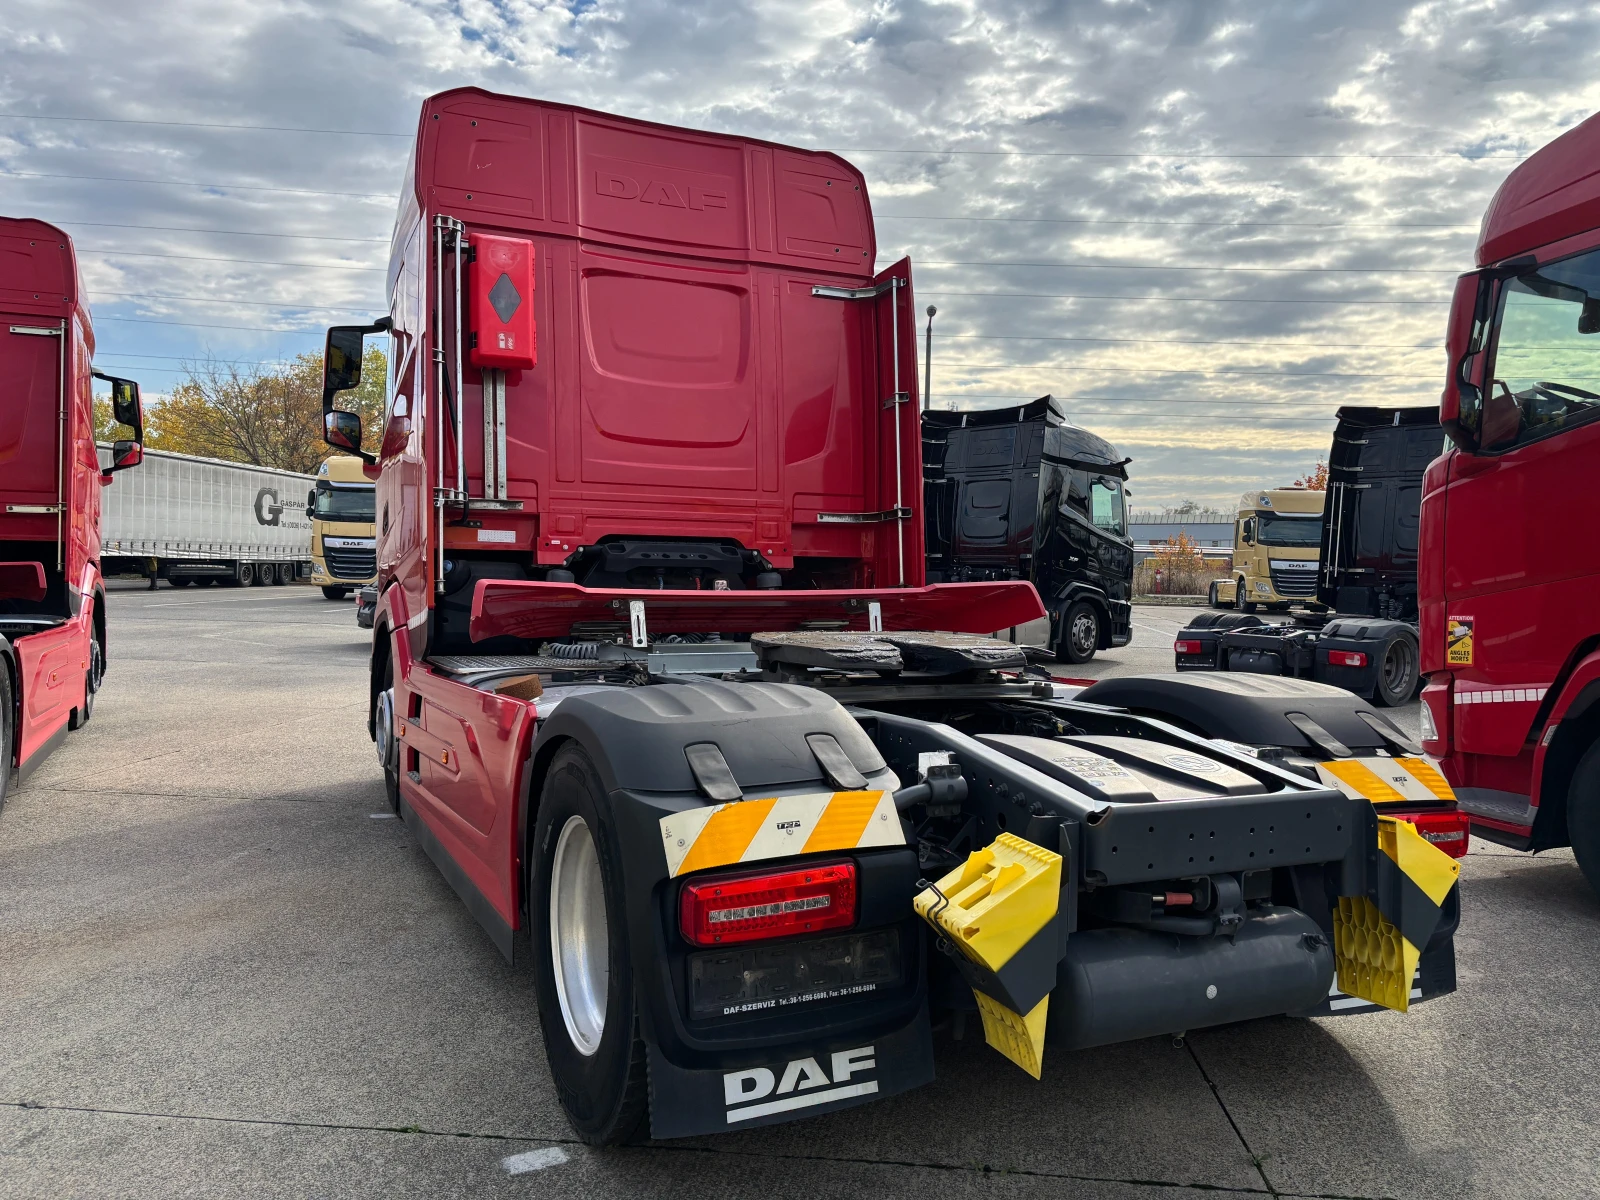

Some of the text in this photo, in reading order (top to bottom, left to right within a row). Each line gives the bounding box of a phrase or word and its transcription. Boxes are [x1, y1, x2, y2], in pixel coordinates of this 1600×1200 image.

[595, 171, 727, 211] DAF
[723, 1000, 776, 1015] DAF-SZERVIZ
[723, 1045, 876, 1106] DAF
